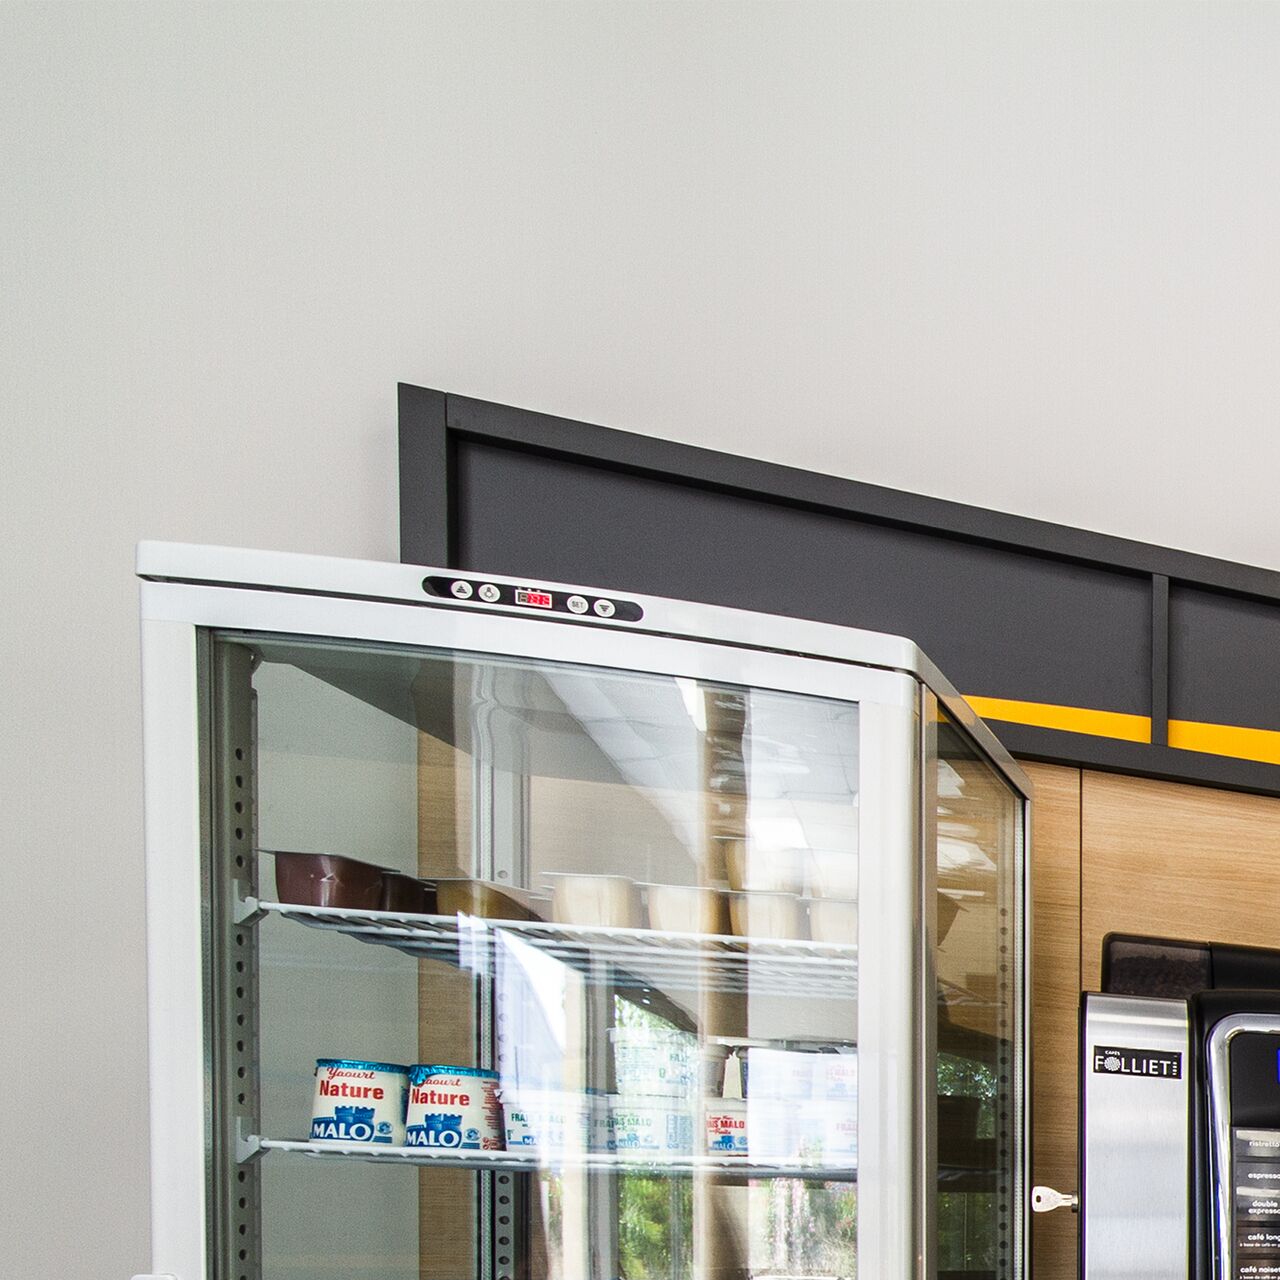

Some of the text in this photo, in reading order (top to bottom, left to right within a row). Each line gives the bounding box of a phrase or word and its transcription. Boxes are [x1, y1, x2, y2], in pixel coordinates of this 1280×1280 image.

[326, 1067, 376, 1080] Yaourt
[320, 1080, 384, 1101] Nature
[411, 1088, 470, 1107] Nature
[313, 1122, 371, 1141] MALO
[407, 1130, 460, 1147] MALO
[1252, 1200, 1278, 1208] double
[1247, 1233, 1265, 1241] café
[1240, 1265, 1258, 1273] café
